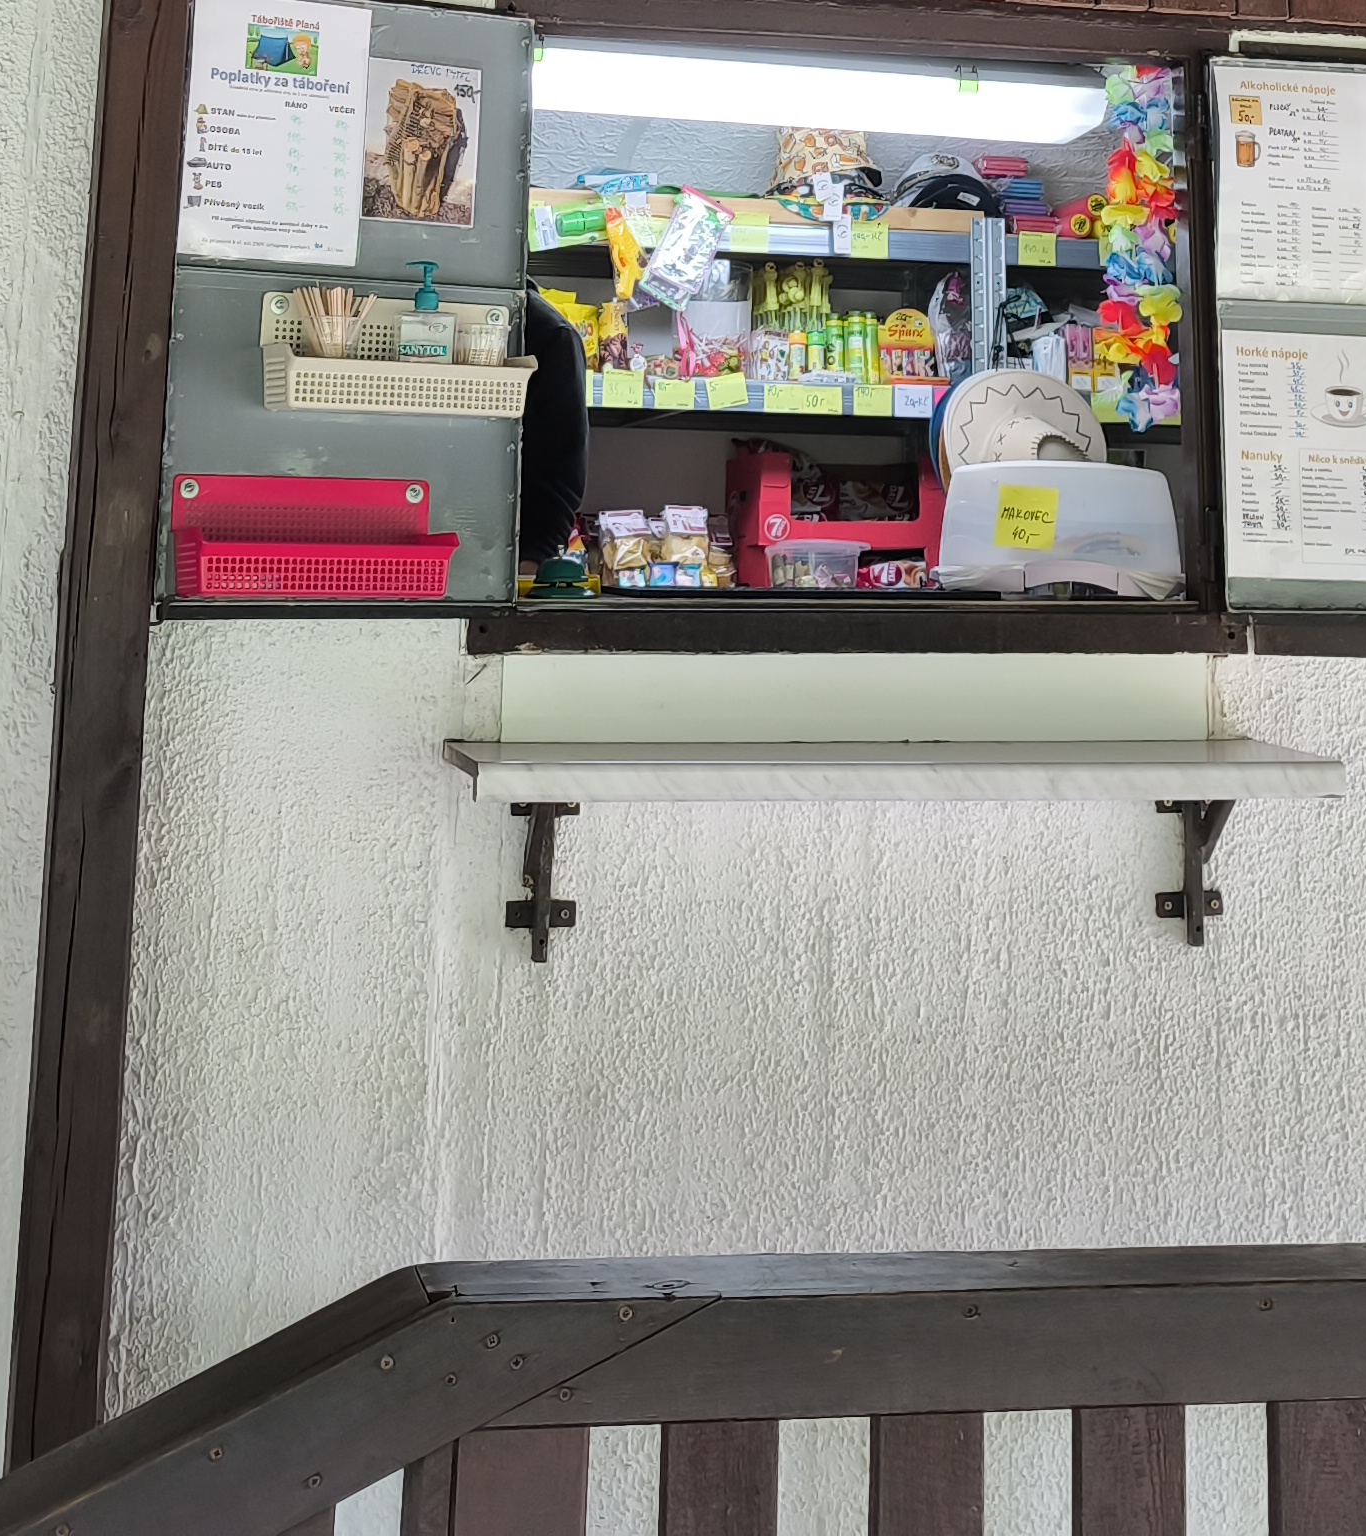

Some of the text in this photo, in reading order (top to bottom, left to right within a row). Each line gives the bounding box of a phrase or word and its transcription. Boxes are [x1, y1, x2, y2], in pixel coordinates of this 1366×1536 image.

[211, 67, 271, 88] Poplatky
[274, 77, 288, 87] za
[293, 77, 350, 94] táboření
[1240, 80, 1335, 96] Alkoholické nápoje
[211, 108, 235, 116] STAN
[329, 106, 355, 114] VEČER
[210, 126, 240, 135] OSOBA
[207, 162, 231, 170] AUTO
[205, 180, 222, 188] PES
[399, 345, 445, 355] SANYTOL
[1236, 346, 1308, 360] Horké nápoje
[1241, 450, 1282, 463] Nanuky
[1309, 454, 1330, 464] Něco
[1333, 455, 1337, 464] k
[1001, 506, 1055, 523] MAKOVEC
